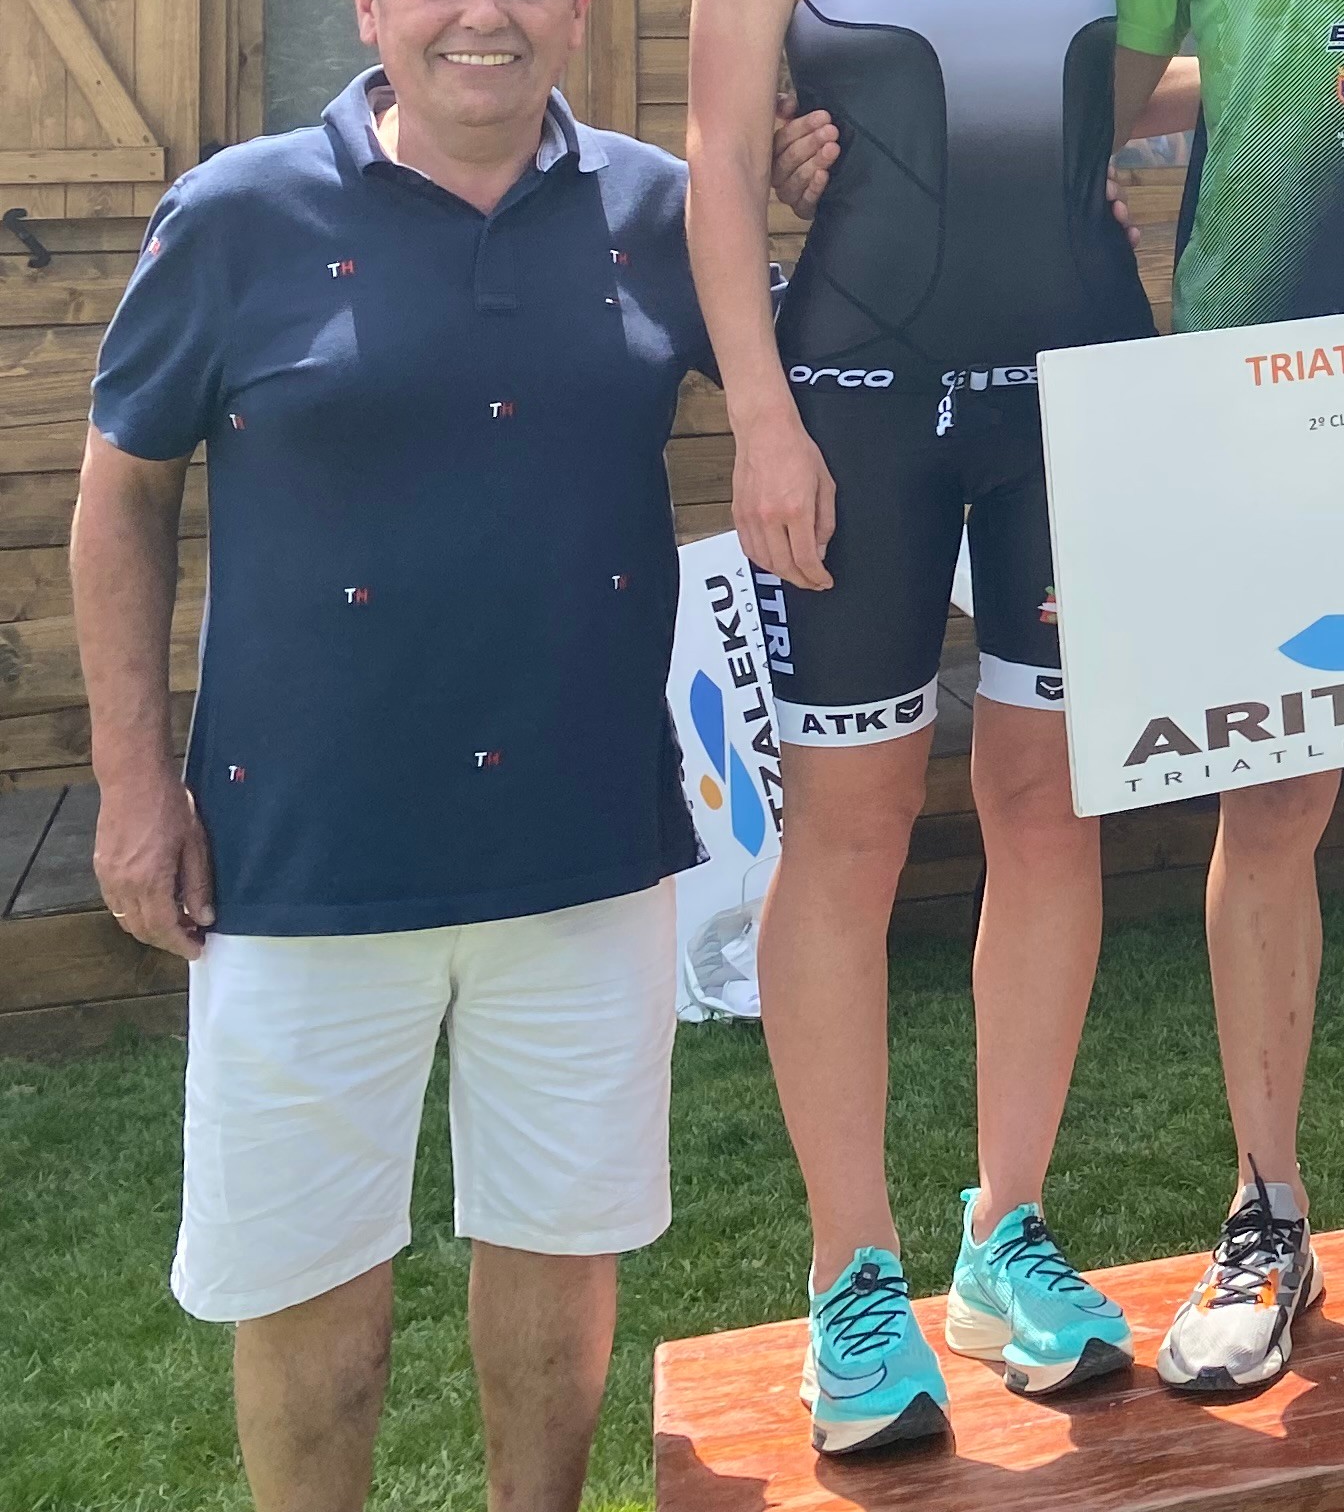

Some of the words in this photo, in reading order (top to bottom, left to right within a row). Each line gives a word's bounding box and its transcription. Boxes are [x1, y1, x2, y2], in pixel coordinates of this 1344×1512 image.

[327, 260, 355, 278] TH
[789, 365, 894, 388] orca
[489, 402, 513, 418] TH
[344, 587, 369, 603] TH
[801, 707, 888, 735] ATK
[475, 751, 500, 767] TH
